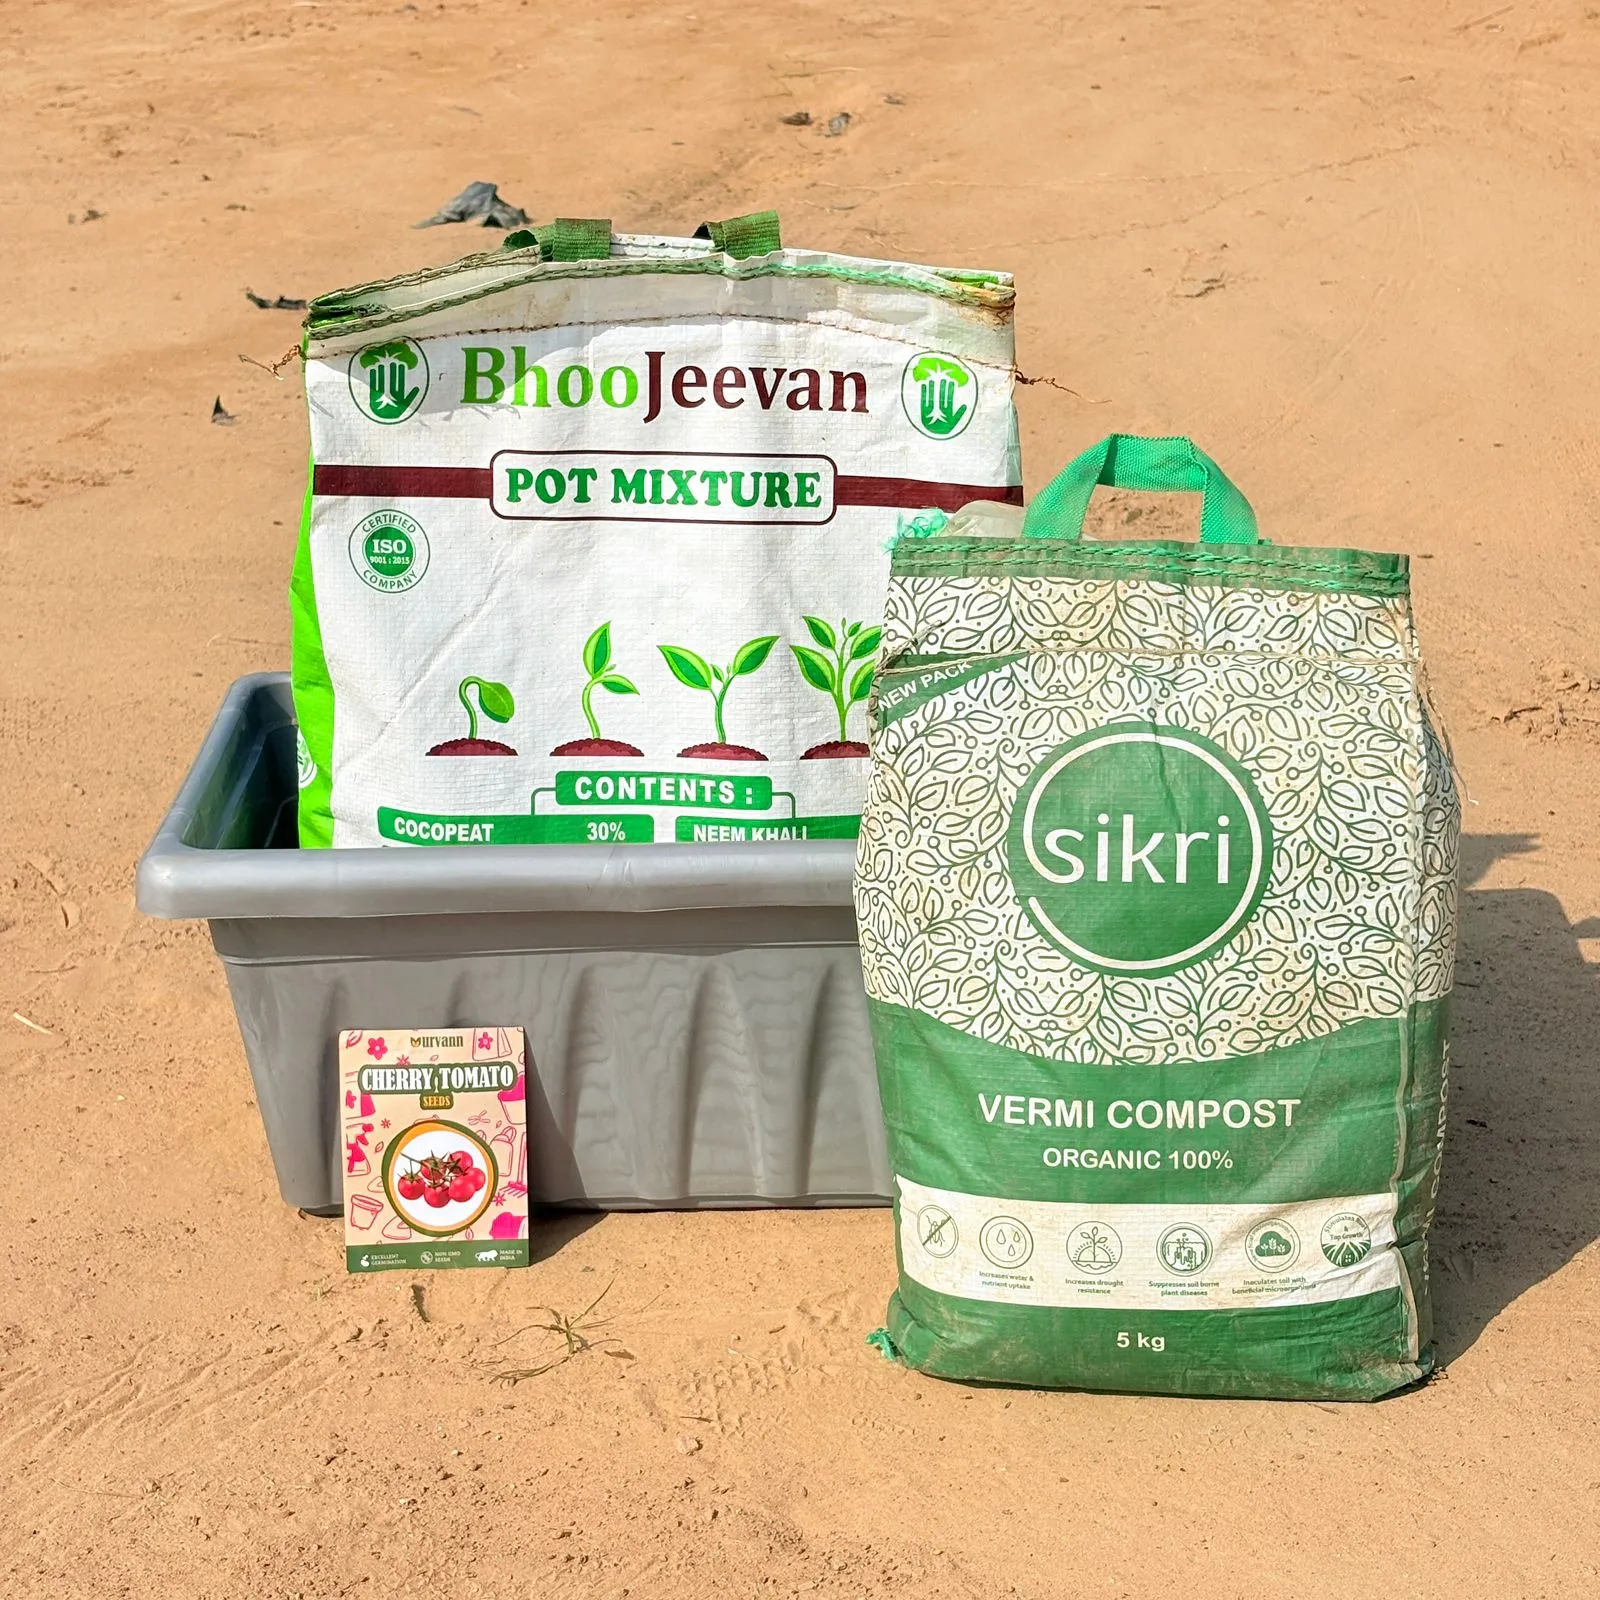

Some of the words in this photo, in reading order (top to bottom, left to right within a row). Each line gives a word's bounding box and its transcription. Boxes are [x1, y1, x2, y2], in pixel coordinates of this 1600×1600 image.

[460, 345, 869, 424] BhooJeevan
[506, 467, 597, 504] POT
[610, 467, 822, 508] MIXTURE
[362, 513, 416, 533] CERTIFIED
[372, 539, 407, 554] ISO
[369, 556, 387, 564] 9001
[393, 556, 410, 565] 2015
[363, 569, 418, 590] COMPANY
[878, 680, 917, 712] NEW
[920, 662, 973, 688] PACK
[574, 776, 735, 805] CONTENTS
[394, 817, 494, 842] COCOPEAT
[587, 821, 626, 841] 30%
[693, 824, 746, 842] NEEM
[1044, 812, 1231, 886] sikri
[361, 1068, 434, 1091] CHERRY
[439, 1065, 514, 1090] TOMATO
[422, 1095, 451, 1107] SEEDS
[978, 1092, 1095, 1129] VERMI
[1107, 1098, 1301, 1130] COMPOST
[1043, 1147, 1161, 1170] ORGANIC
[1168, 1149, 1234, 1170] 100%
[979, 1271, 1008, 1280] Increases
[1008, 1282, 1031, 1290] uptake
[1065, 1278, 1096, 1286] Increases
[1097, 1279, 1124, 1287] drought
[1279, 1277, 1290, 1285] soil
[1292, 1276, 1306, 1284] with
[1161, 1289, 1179, 1297] plant
[1116, 1332, 1130, 1349] 5
[1136, 1330, 1166, 1353] kg
